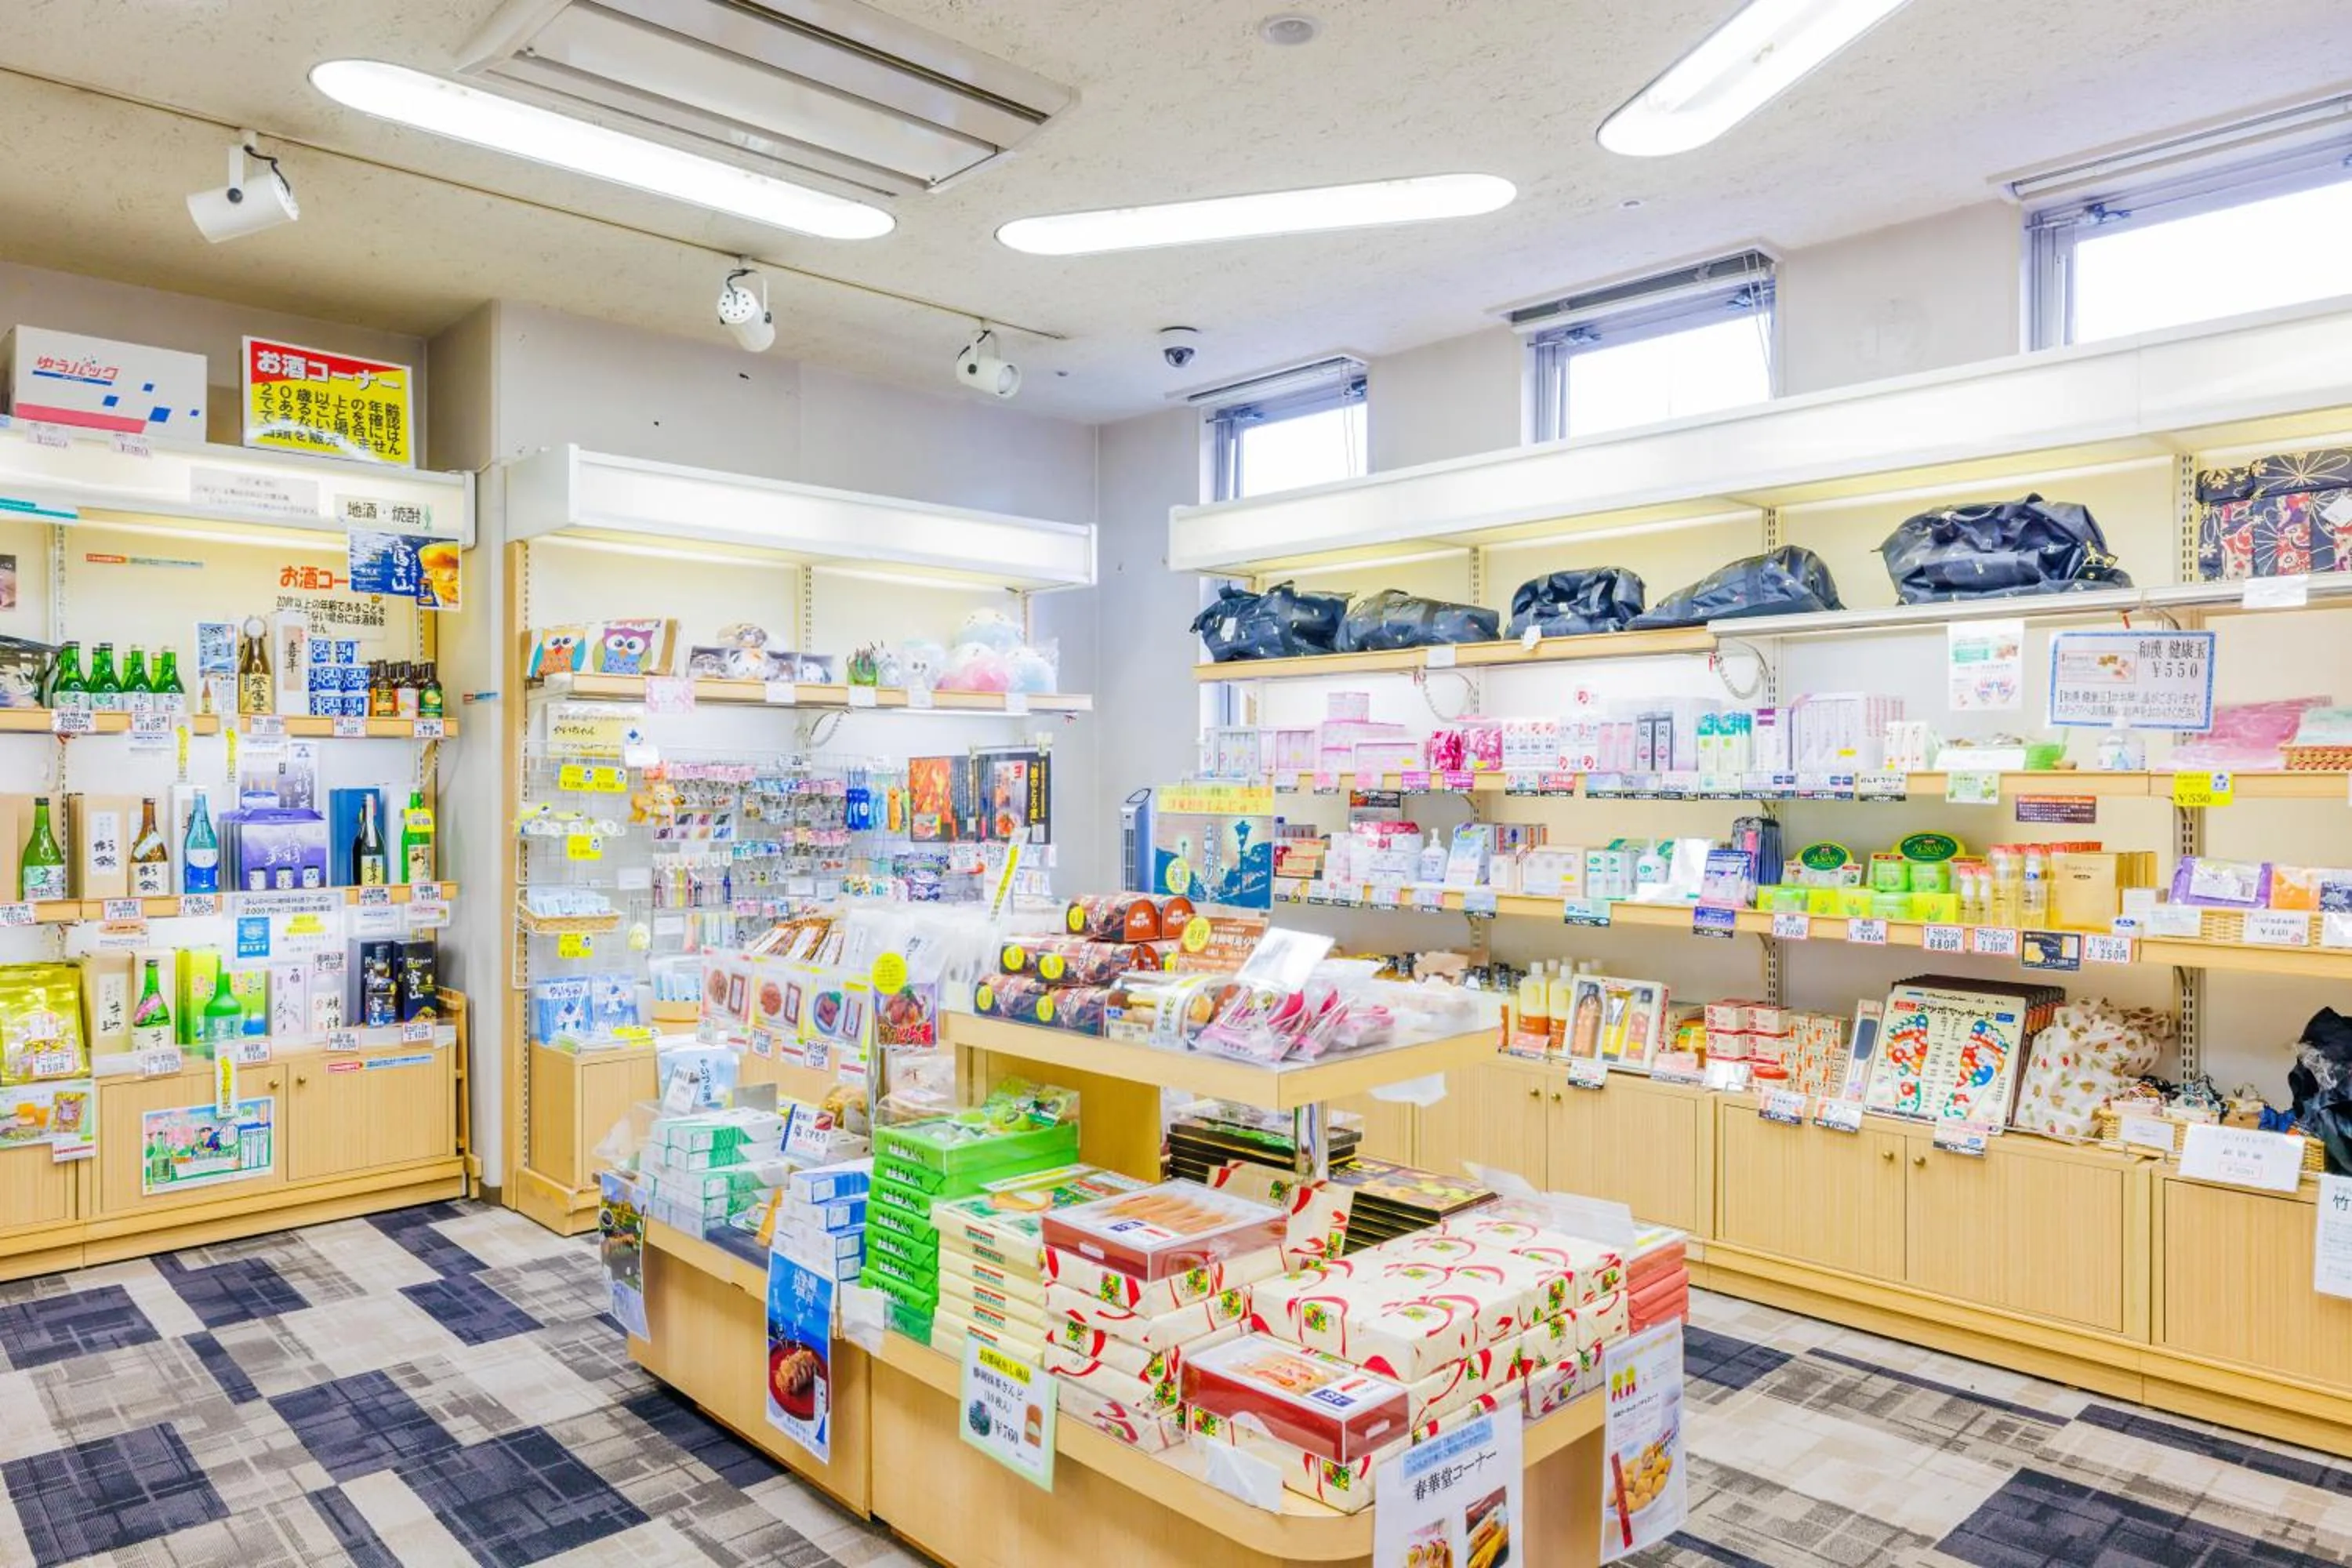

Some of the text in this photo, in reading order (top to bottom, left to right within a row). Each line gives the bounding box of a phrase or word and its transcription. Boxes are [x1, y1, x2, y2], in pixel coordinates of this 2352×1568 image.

[37, 355, 119, 380] ゆうパック
[257, 350, 401, 390] お酒コーナー
[1415, 1450, 1497, 1501] 春華堂コーナー
